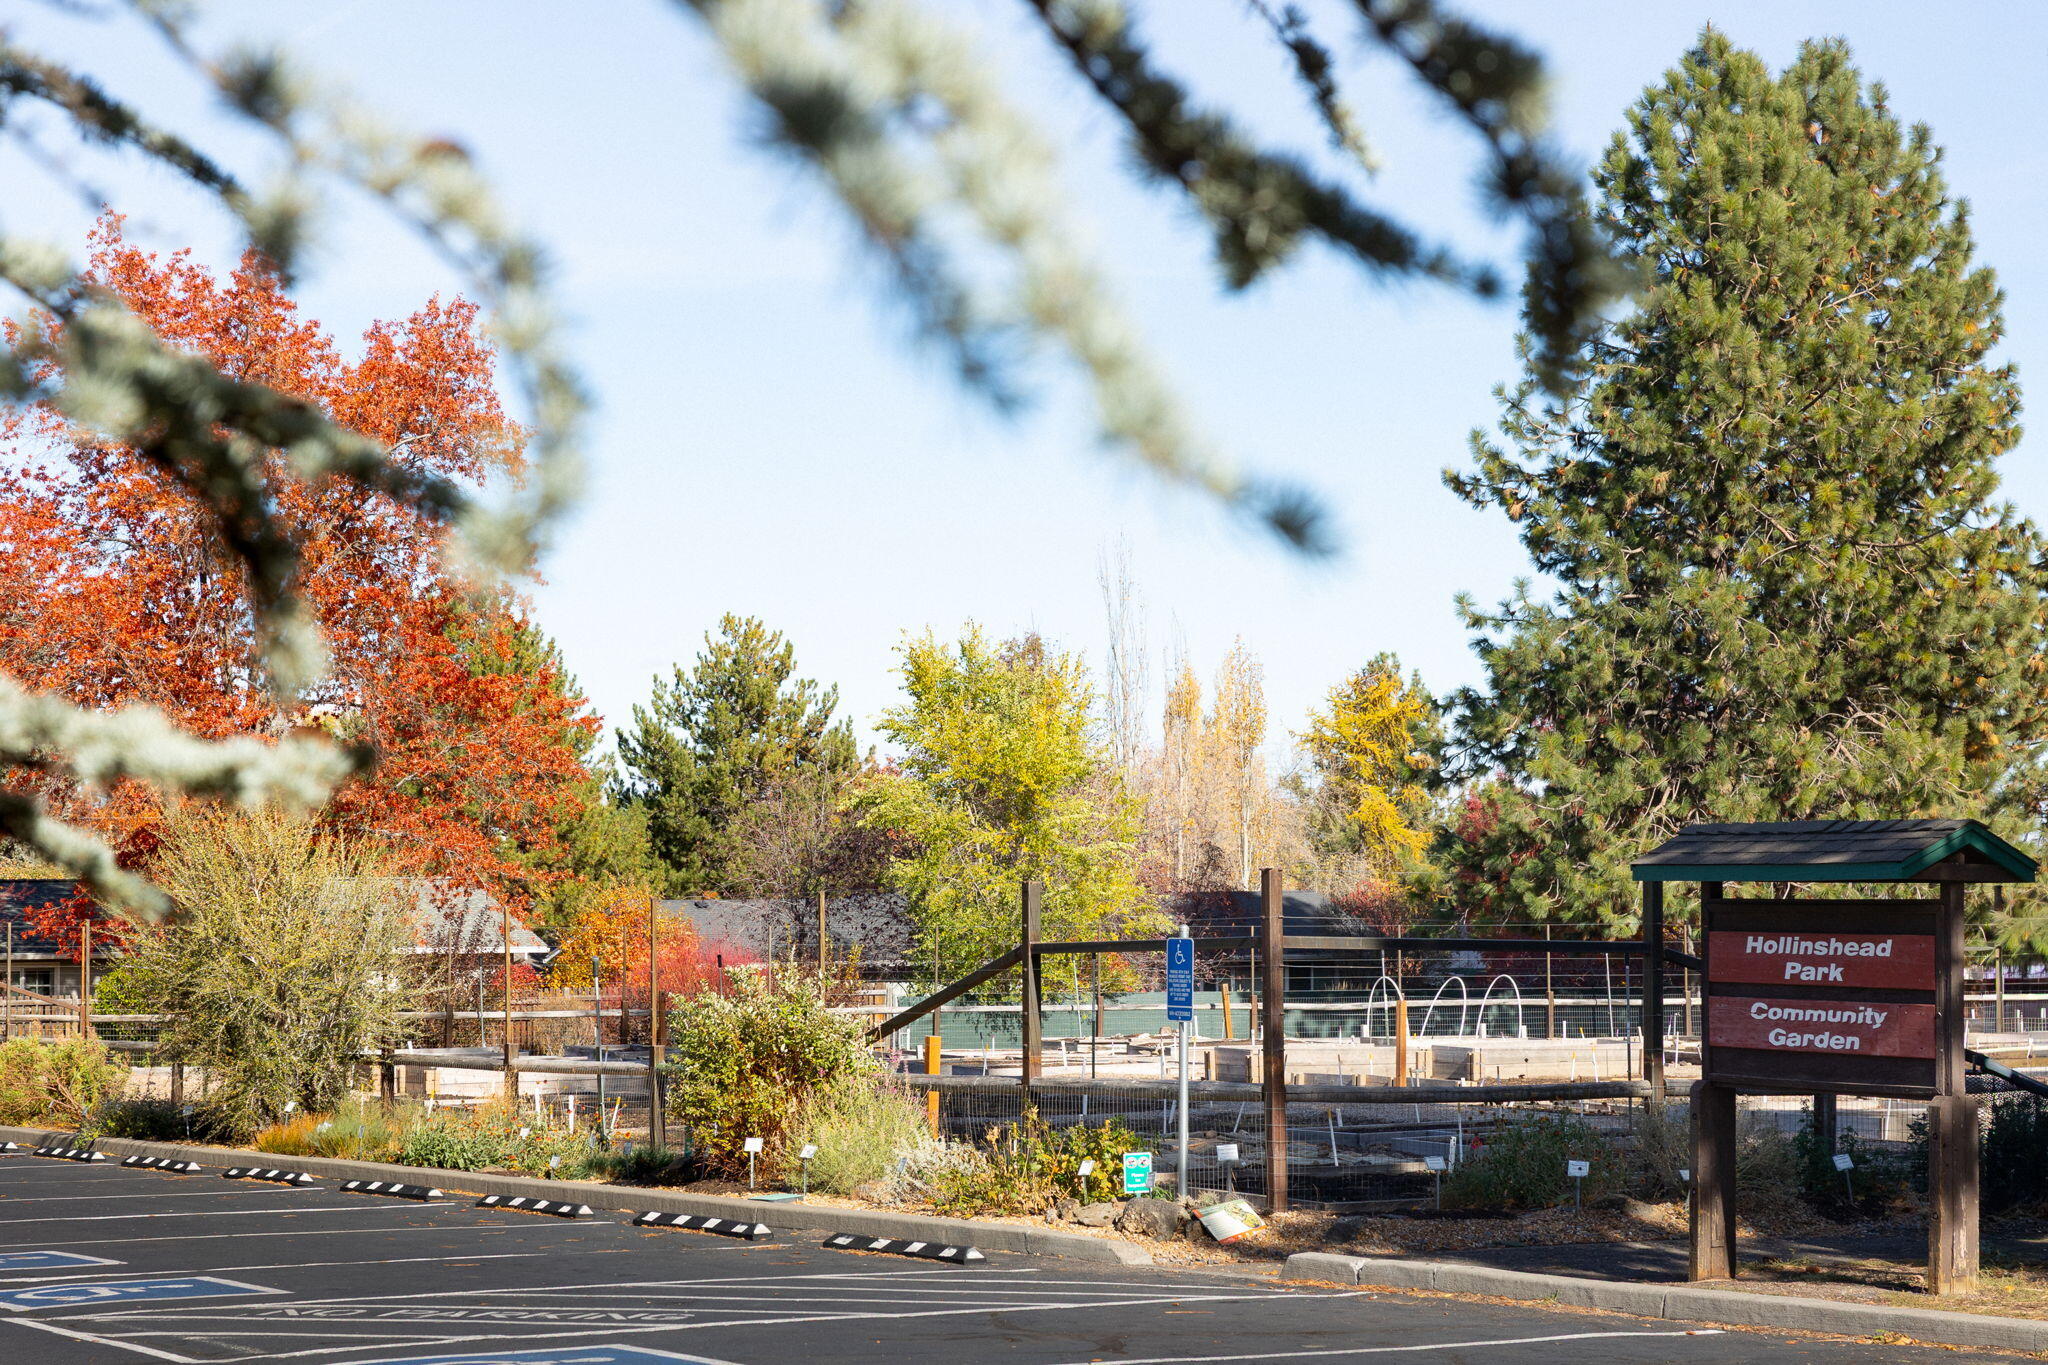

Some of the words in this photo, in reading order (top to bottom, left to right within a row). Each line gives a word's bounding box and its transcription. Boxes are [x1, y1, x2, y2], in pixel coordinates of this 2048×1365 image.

[1746, 936, 1892, 957] Hollinshead
[1784, 962, 1844, 982] Park
[1750, 1002, 1887, 1028] Community
[1768, 1028, 1860, 1050] Garden
[256, 1309, 368, 1317] NO
[377, 1309, 696, 1321] PARKING
